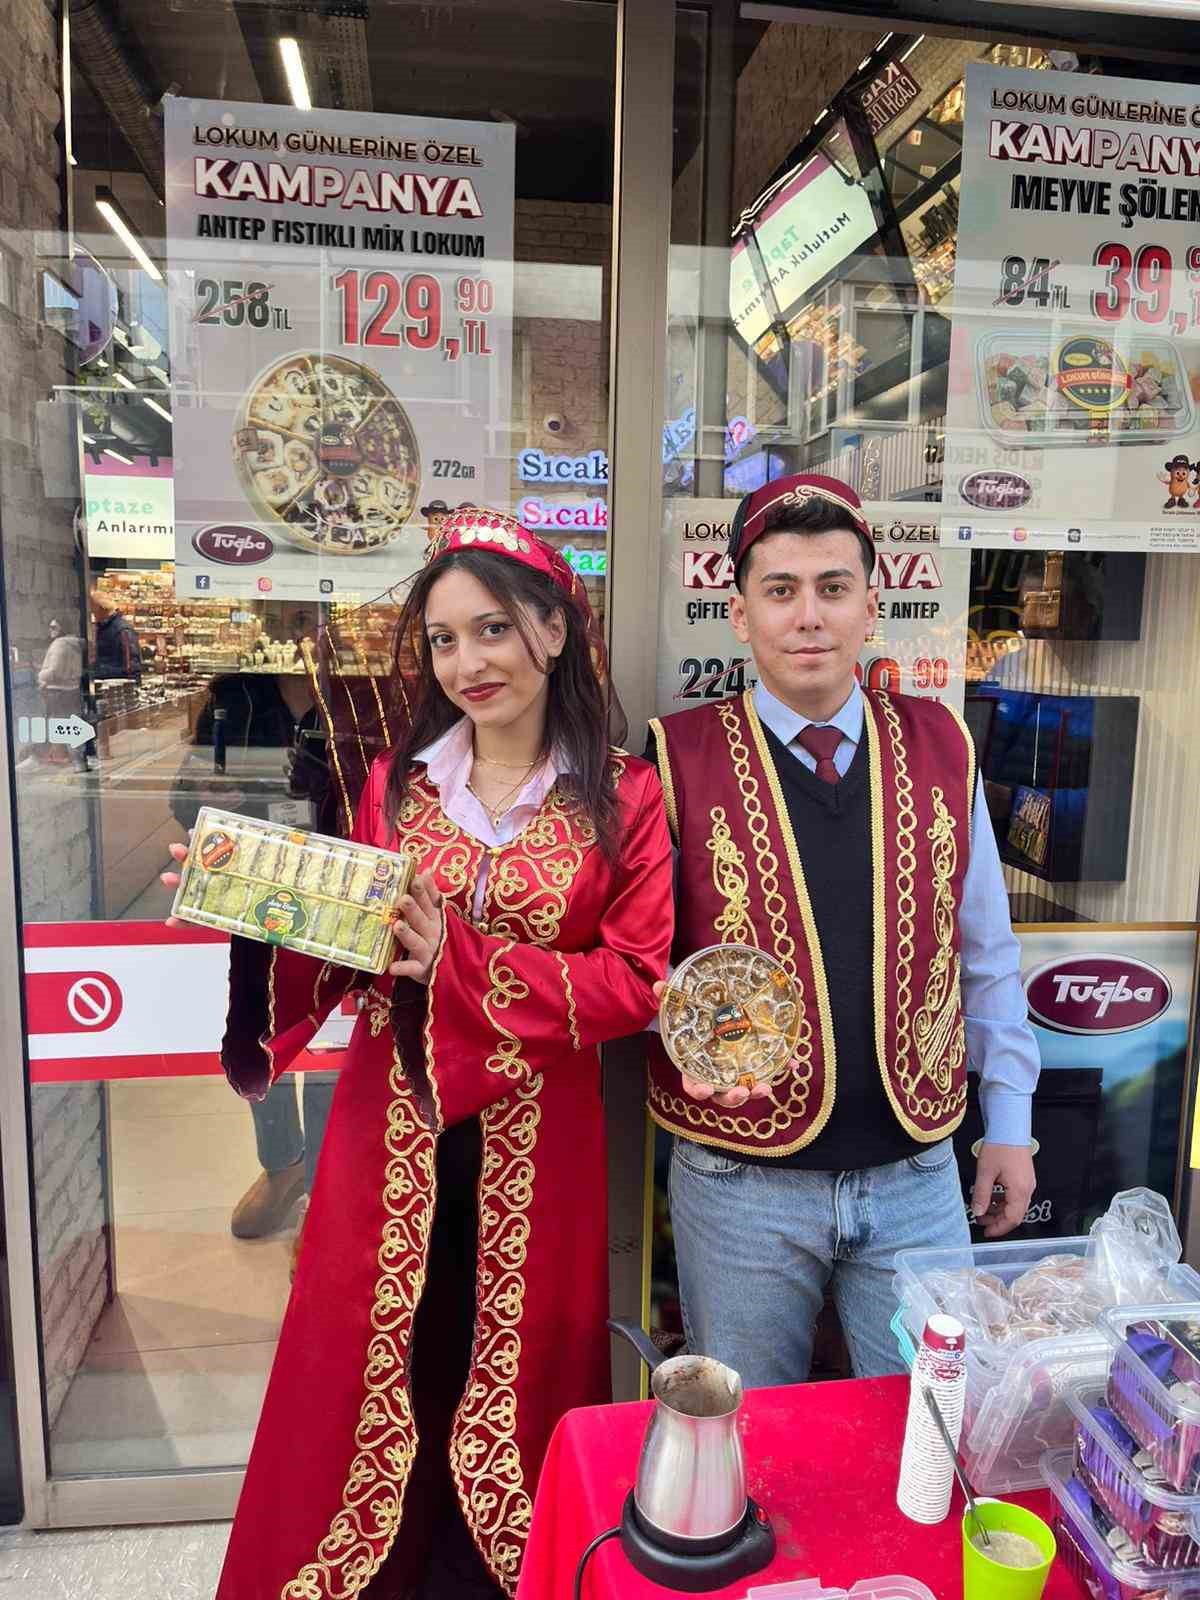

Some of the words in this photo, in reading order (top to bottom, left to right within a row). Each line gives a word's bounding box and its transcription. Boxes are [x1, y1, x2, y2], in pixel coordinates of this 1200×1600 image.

[992, 89, 1065, 112] LOKUM
[1072, 97, 1186, 127] GÜNLERİNE
[194, 125, 278, 149] LOKUM
[286, 131, 417, 162] GÜNLERİNE
[424, 140, 483, 166] ÖZEL
[193, 156, 484, 218] KAMPANYA
[1010, 174, 1111, 216] MEYVE
[198, 214, 266, 242] ANTEP
[272, 220, 355, 250] FISTIKLI
[363, 224, 405, 252] MİX
[411, 231, 485, 258] LOKUM
[456, 275, 495, 315] 90
[1000, 254, 1052, 308] 84
[1051, 284, 1071, 310] TL
[196, 278, 270, 329] 258
[271, 308, 292, 331] TL
[464, 320, 492, 356] TL
[523, 452, 608, 480] Sıcak
[523, 501, 608, 526] Sıcak
[889, 520, 940, 542] ÖZEL
[687, 598, 728, 625] ÇİFTE
[890, 601, 940, 619] ANTEP
[680, 656, 747, 699] 224
[914, 656, 951, 689] 90
